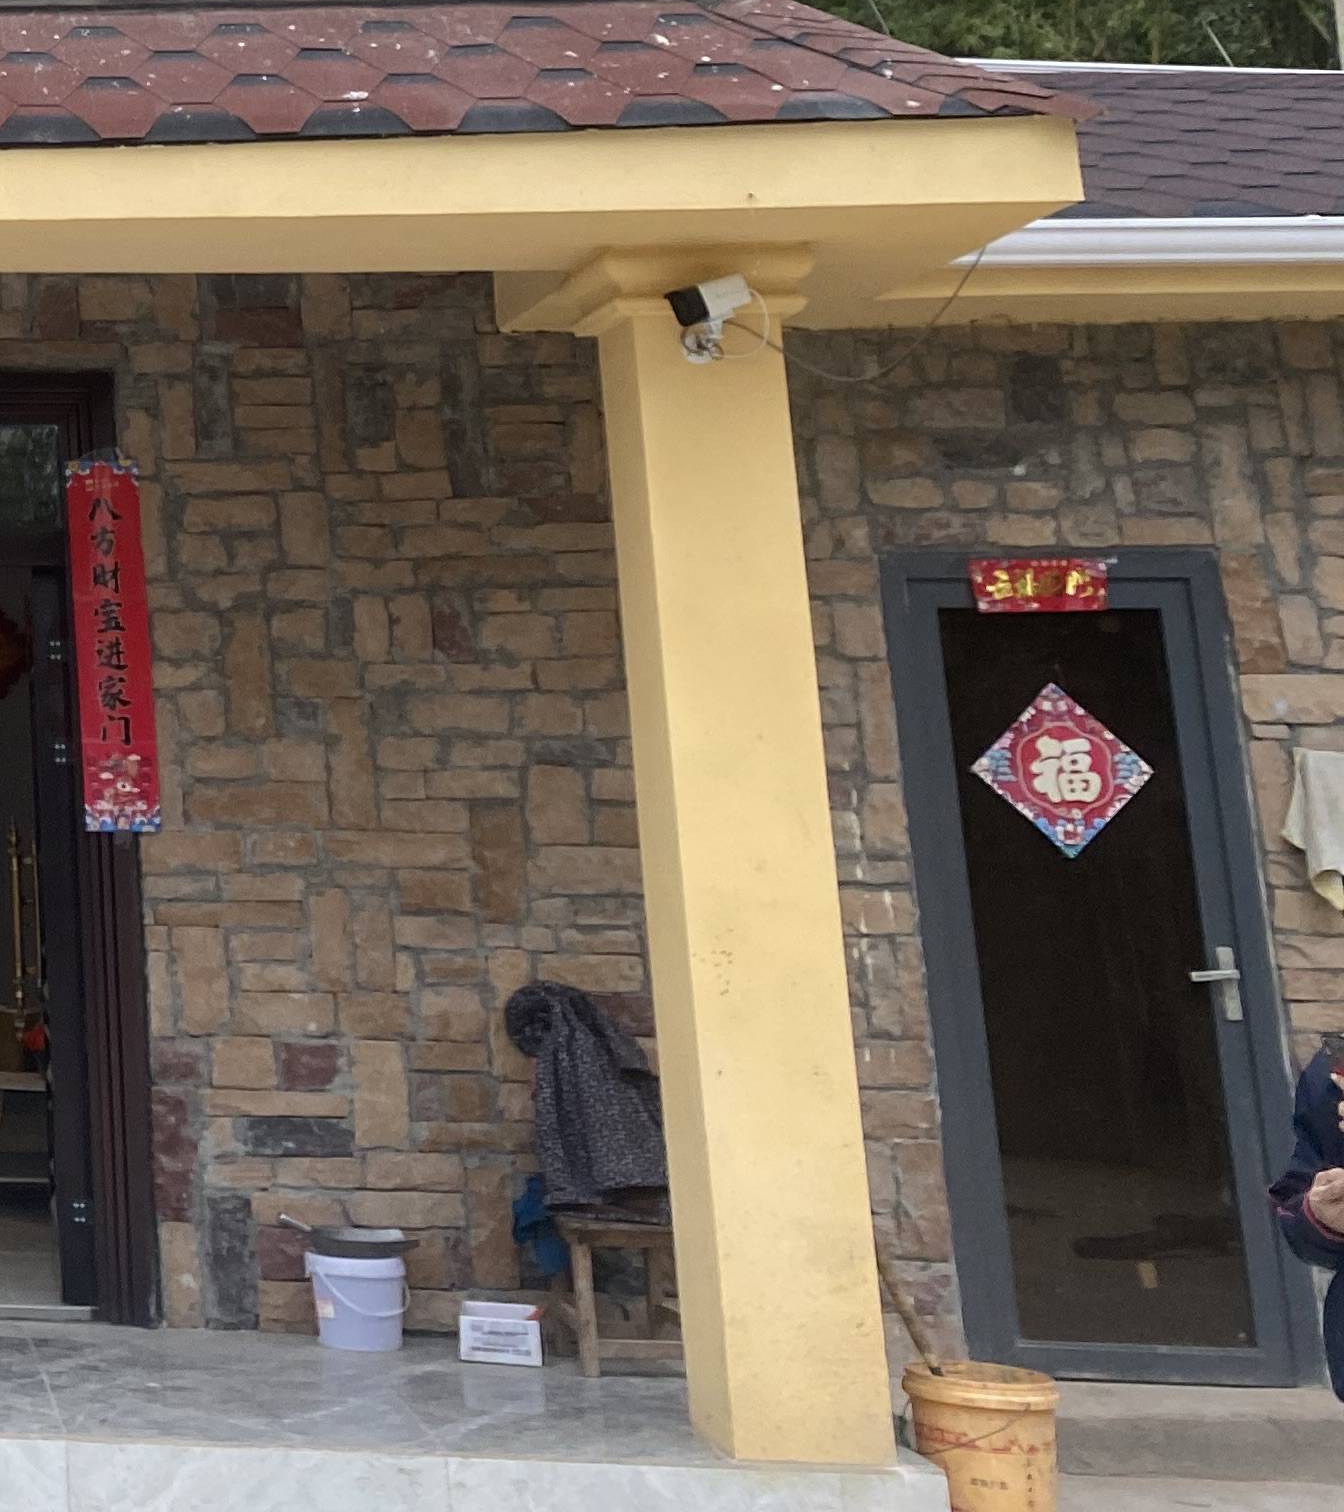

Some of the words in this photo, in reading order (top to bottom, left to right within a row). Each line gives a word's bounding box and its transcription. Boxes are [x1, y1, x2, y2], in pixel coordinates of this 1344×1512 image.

[88, 496, 132, 747] 八方财宝进家门
[1029, 734, 1102, 804] 福
